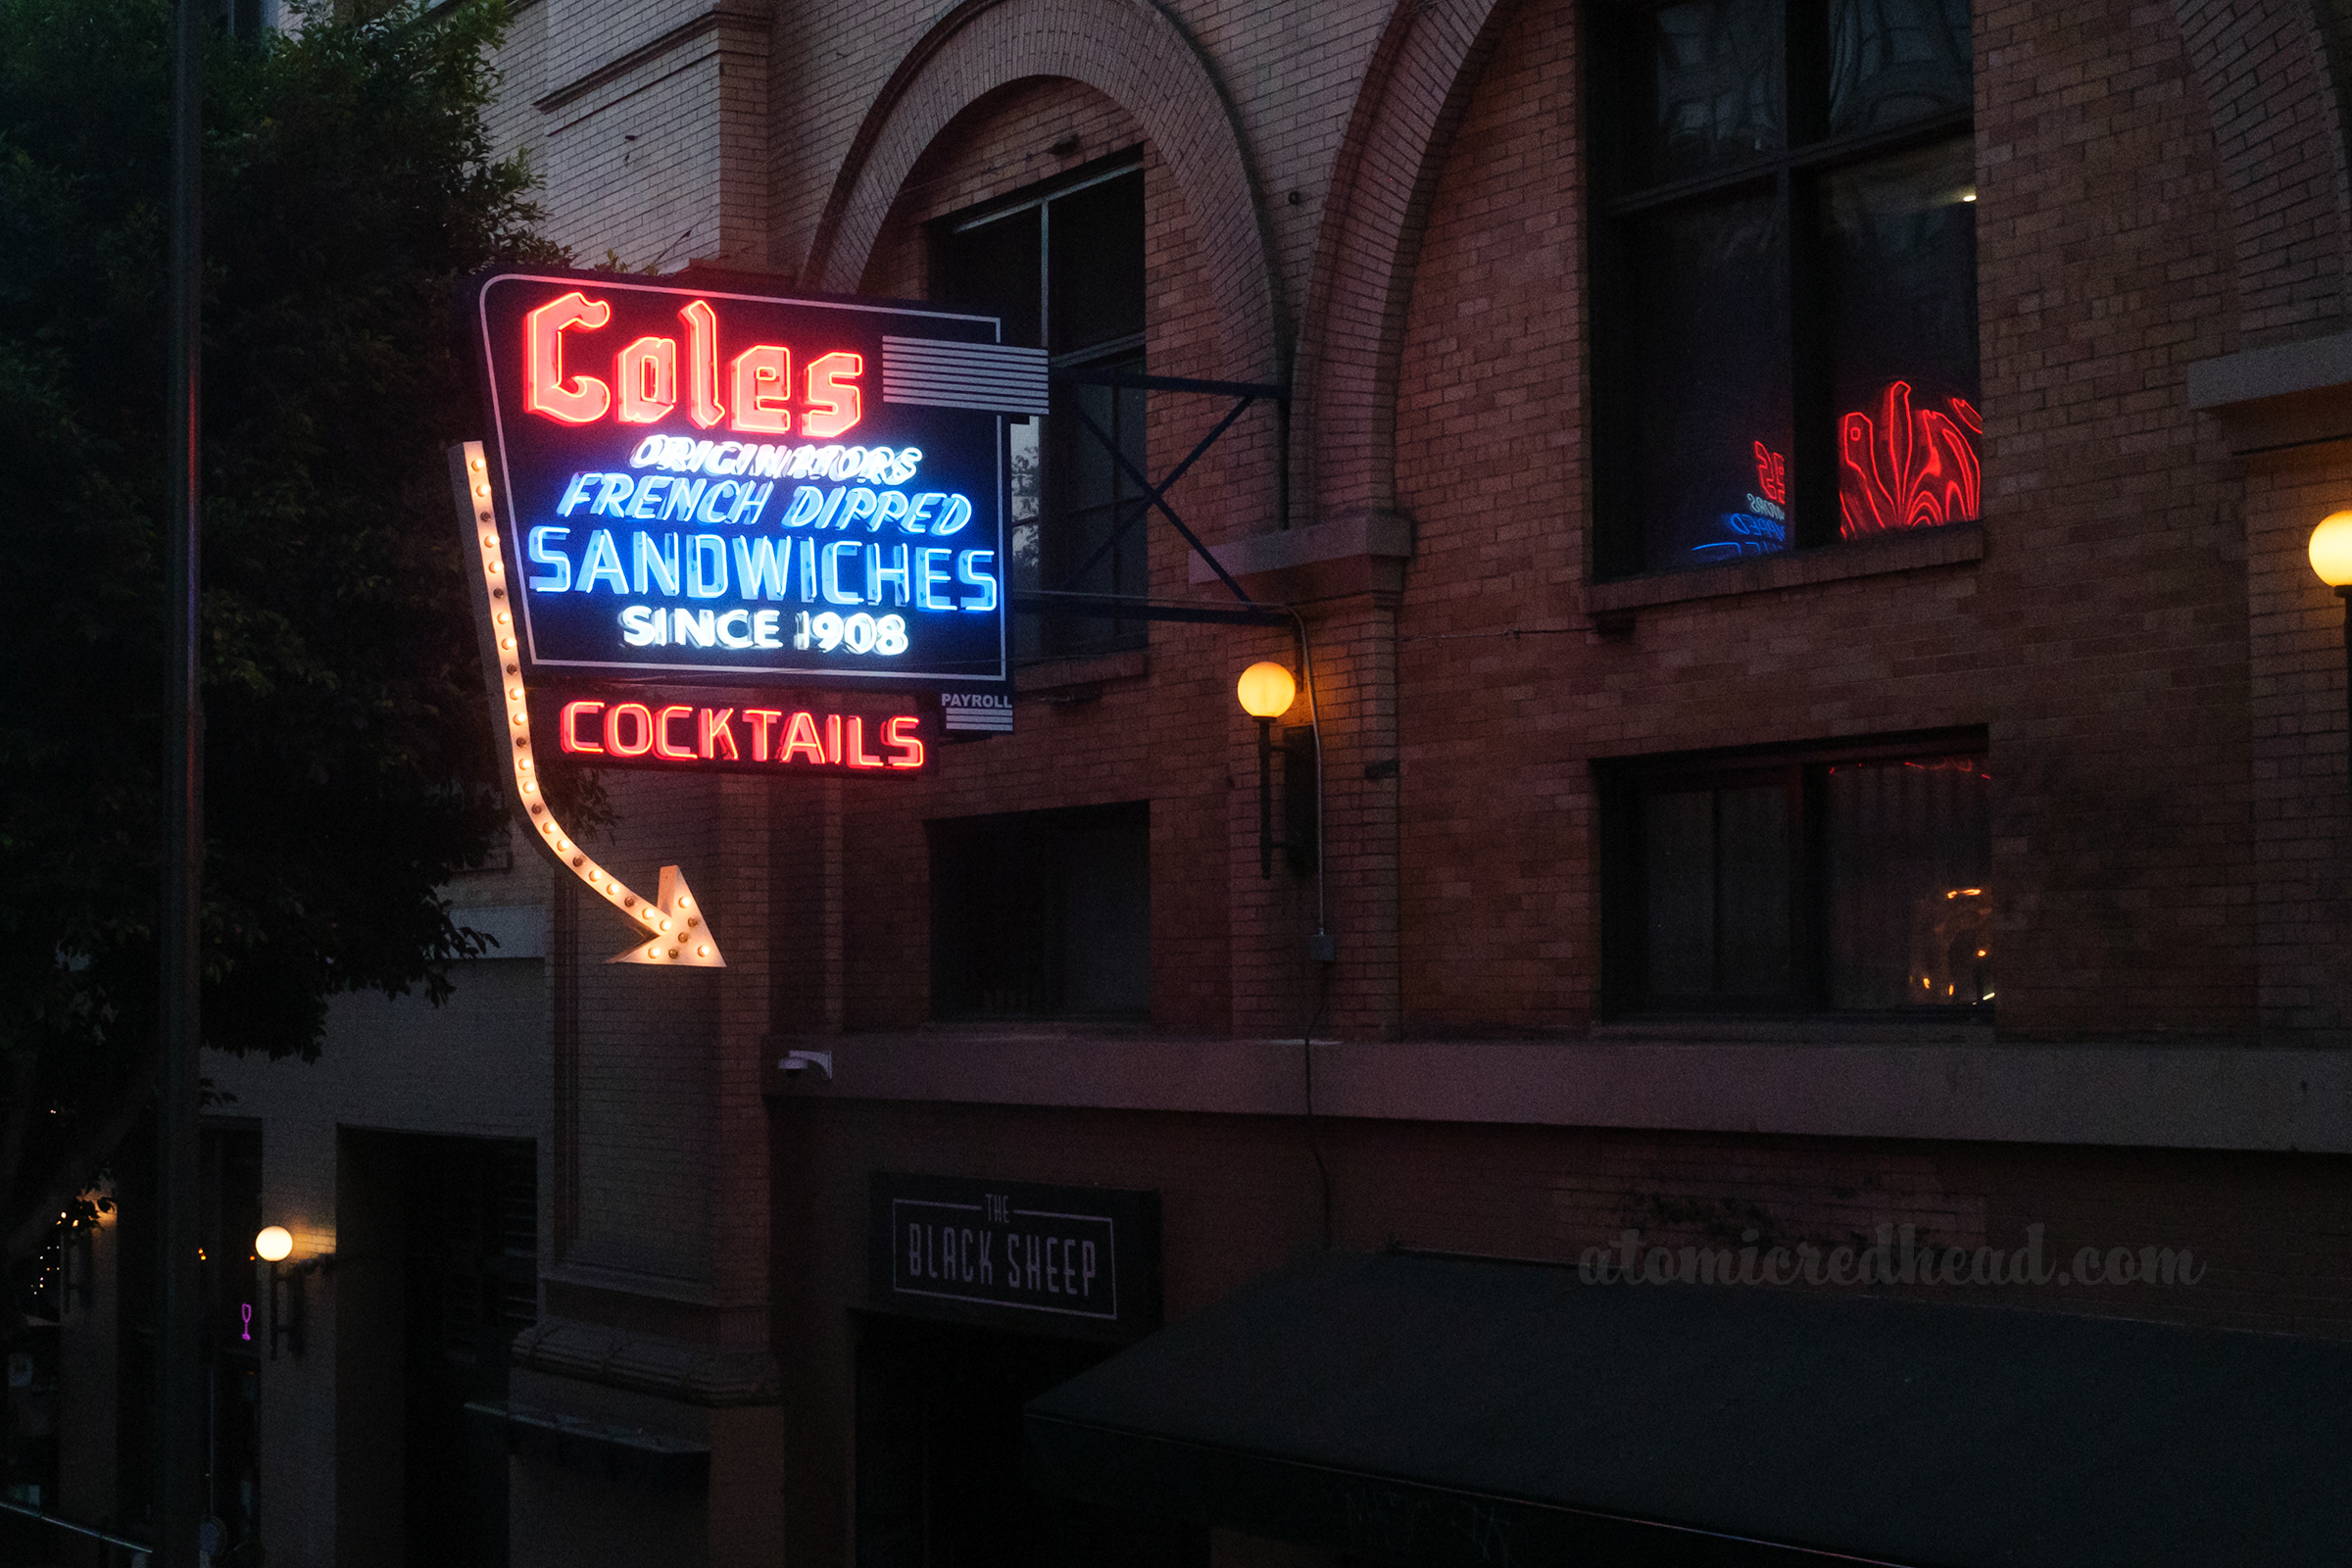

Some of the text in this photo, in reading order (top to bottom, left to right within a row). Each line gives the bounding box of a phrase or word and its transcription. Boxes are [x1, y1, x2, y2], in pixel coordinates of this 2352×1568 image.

[523, 291, 864, 437] Coles
[629, 433, 923, 485] ORIGINATORS
[557, 471, 973, 536] FRENCH DIPPED
[528, 524, 999, 612] SANDWICHES
[618, 605, 910, 656] SINCE 1908
[941, 692, 1012, 710] PAYROLL
[561, 700, 925, 768] COCKTAILS
[985, 1193, 1010, 1223] THE
[907, 1222, 1097, 1298] BLACK SHEEP
